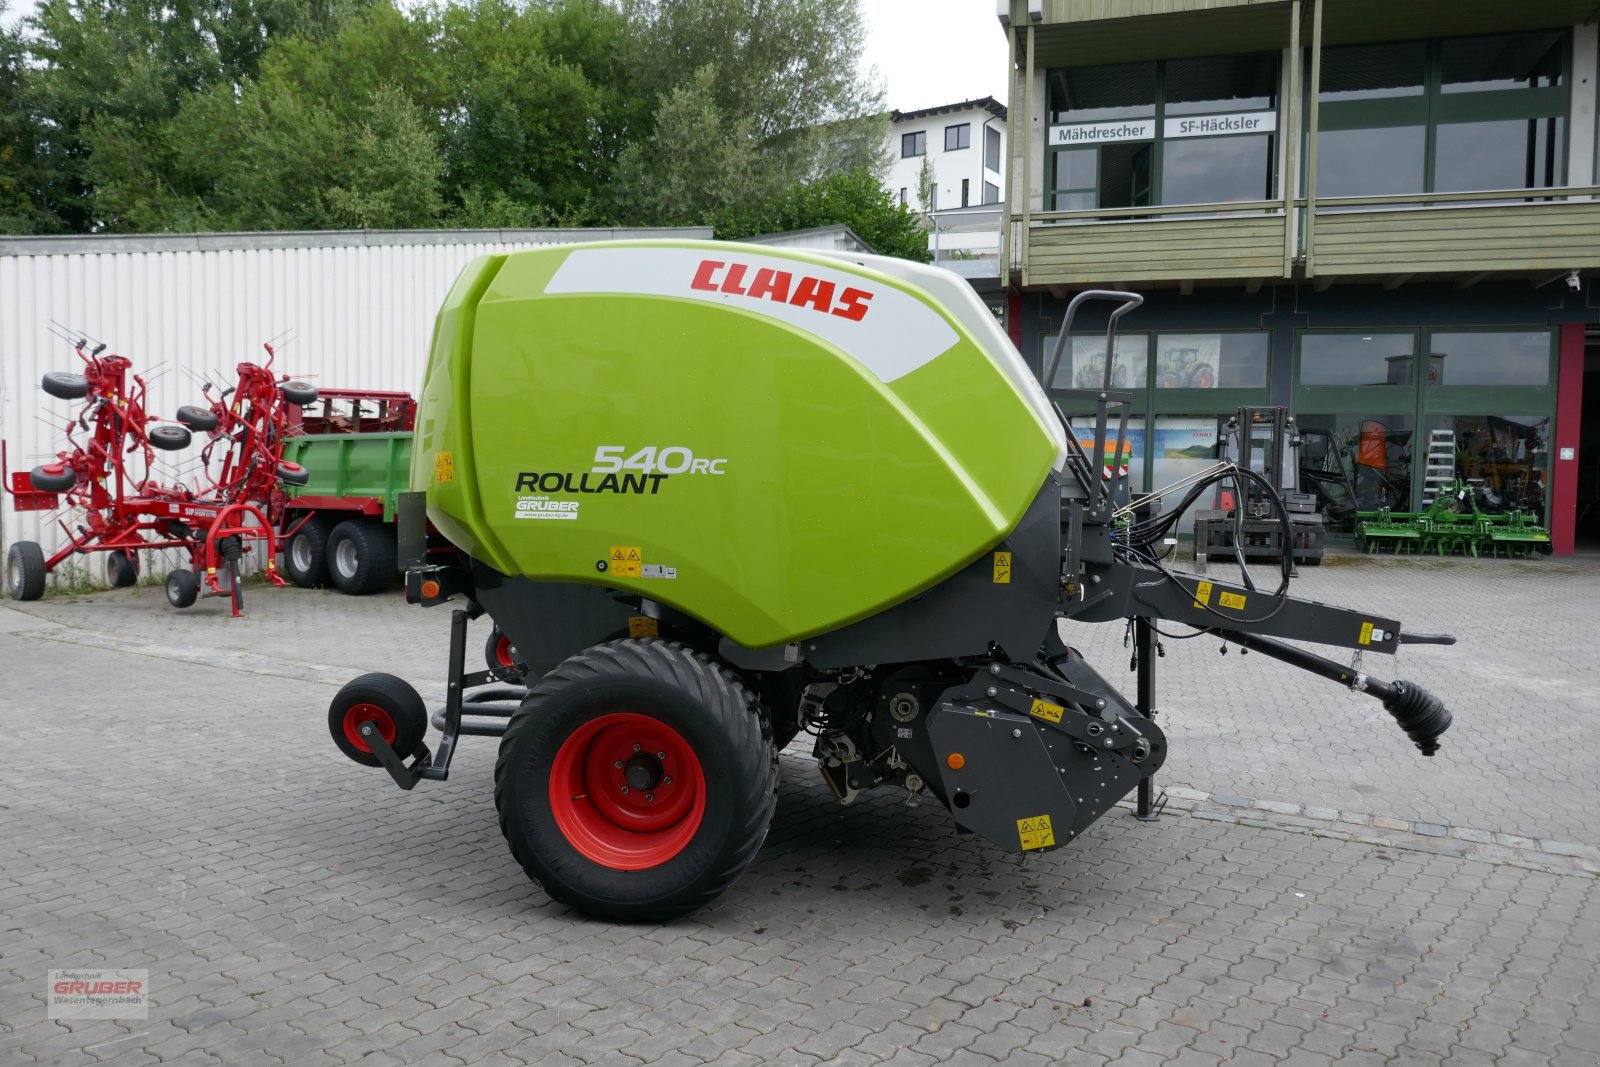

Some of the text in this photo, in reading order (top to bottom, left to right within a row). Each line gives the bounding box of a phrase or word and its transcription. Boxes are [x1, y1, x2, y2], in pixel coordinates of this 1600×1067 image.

[1058, 125, 1146, 141] Mähdrescher
[1179, 117, 1260, 133] SF-Häcksler
[690, 259, 875, 322] CLAAS
[514, 472, 669, 495] ROLLANT
[516, 500, 580, 512] GRUBER
